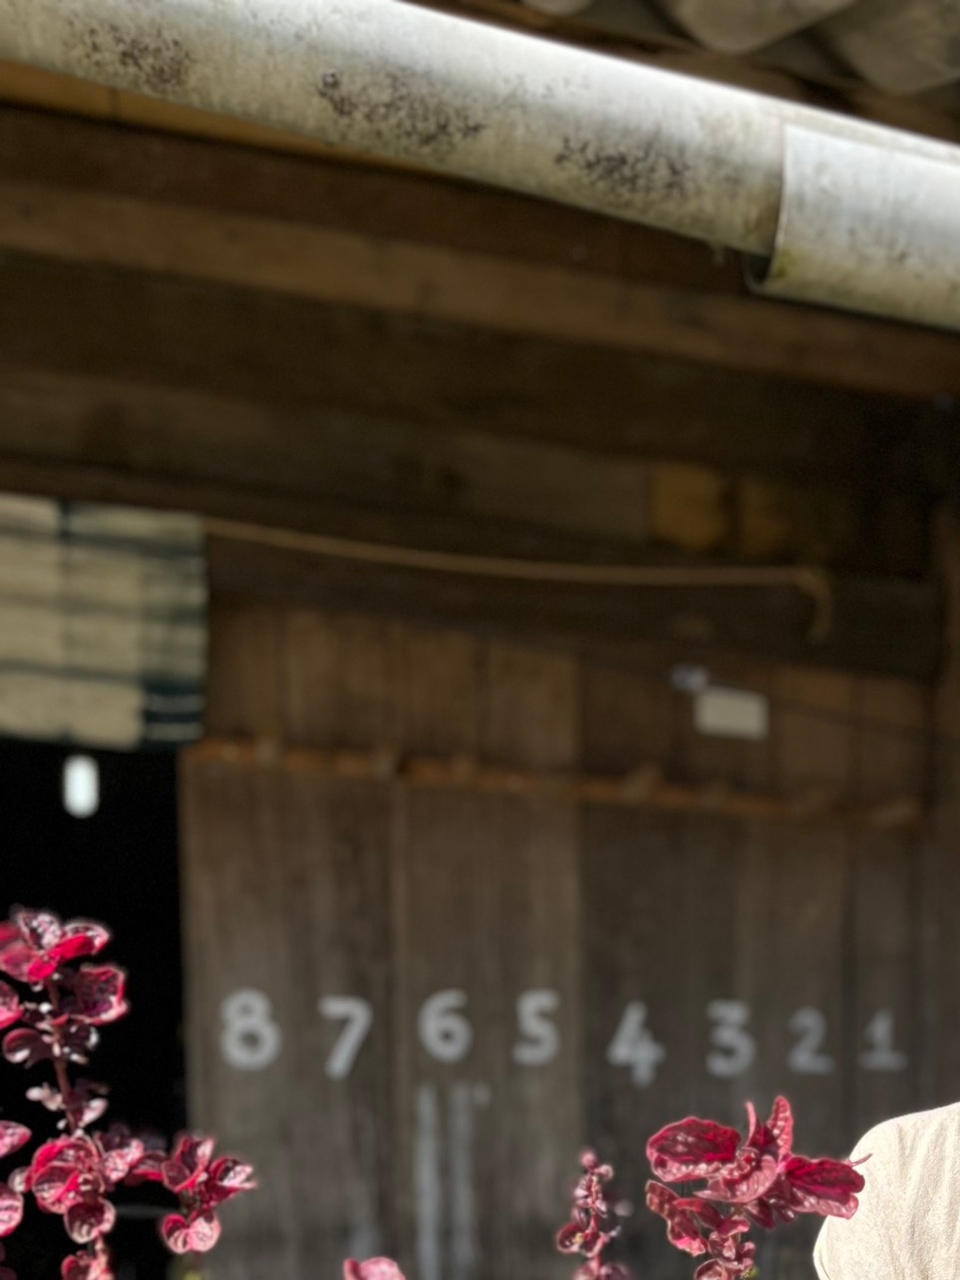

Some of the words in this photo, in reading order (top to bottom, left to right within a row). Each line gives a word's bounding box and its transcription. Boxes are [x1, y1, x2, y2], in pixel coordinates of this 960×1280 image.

[220, 988, 281, 1070] 8
[319, 995, 373, 1080] 7
[417, 989, 472, 1063] 6
[513, 989, 560, 1066] 5
[607, 1002, 666, 1086] 4
[707, 1000, 757, 1077] 3
[786, 1006, 832, 1074] 2
[861, 1011, 905, 1072] 1
